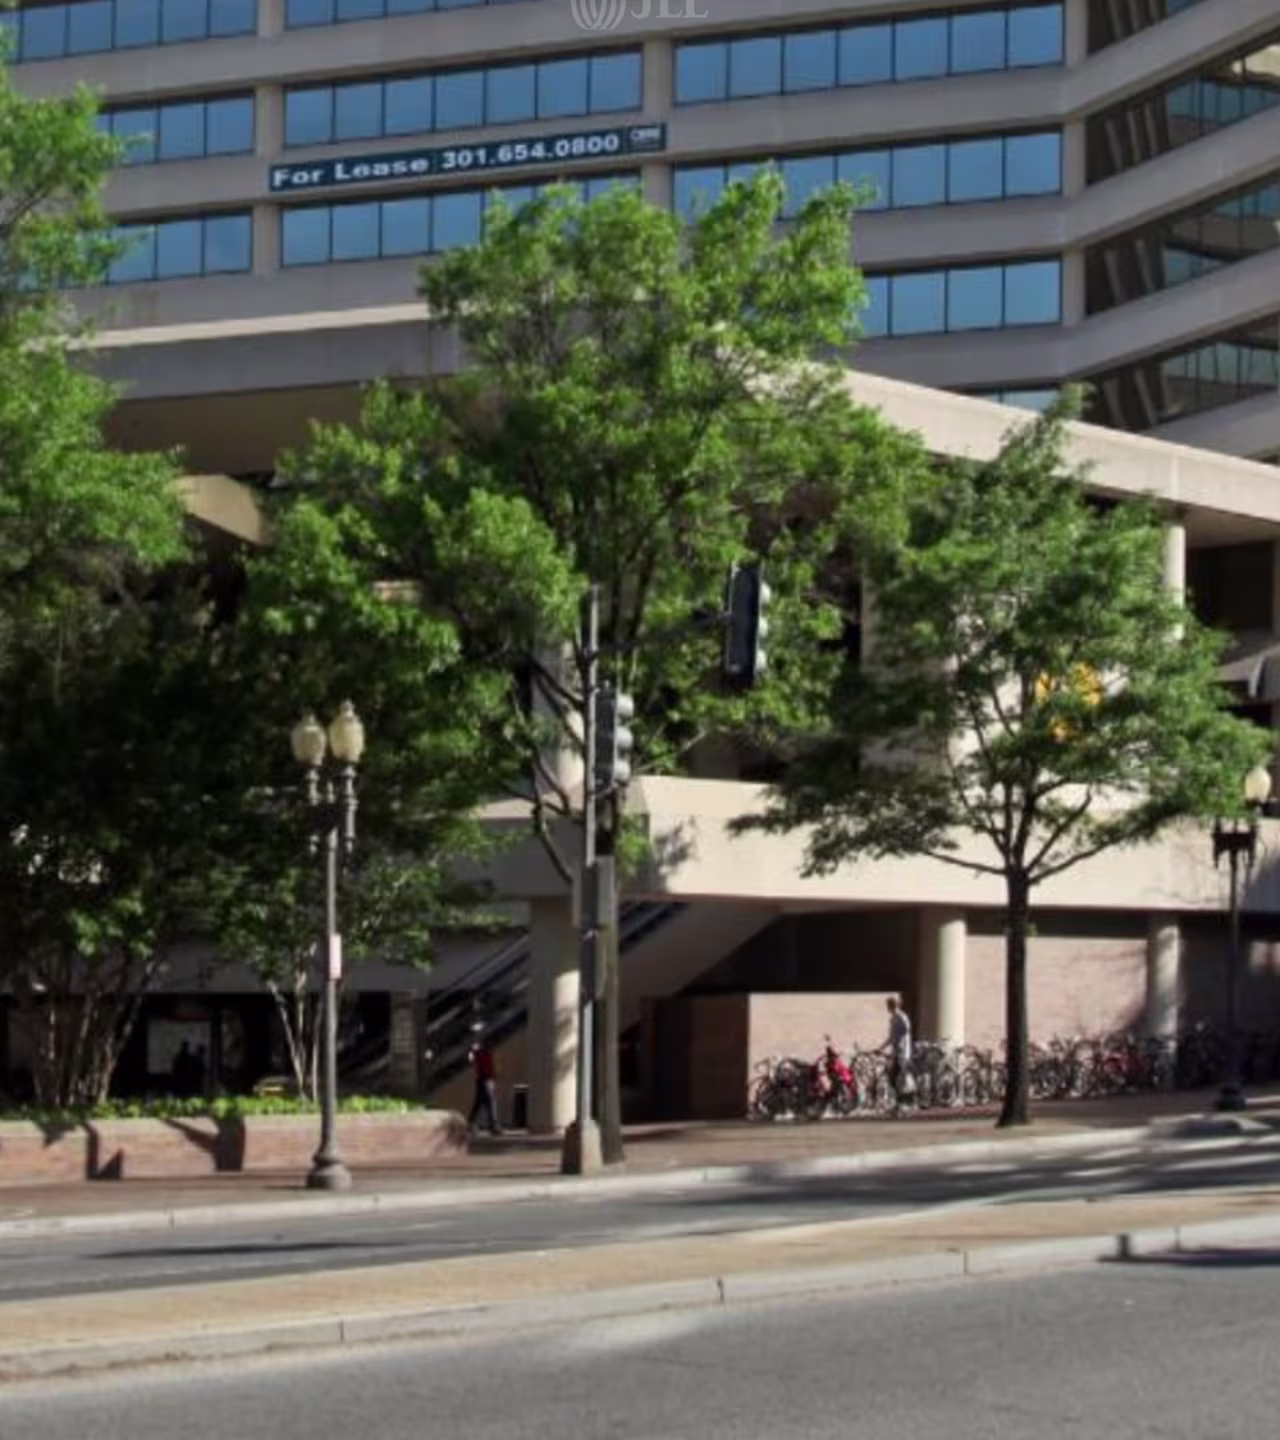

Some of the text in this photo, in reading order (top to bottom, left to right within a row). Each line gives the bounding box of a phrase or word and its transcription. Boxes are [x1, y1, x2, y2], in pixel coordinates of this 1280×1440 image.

[272, 168, 323, 187] For
[335, 159, 429, 180] Lease
[441, 134, 619, 169] 301.654.0800
